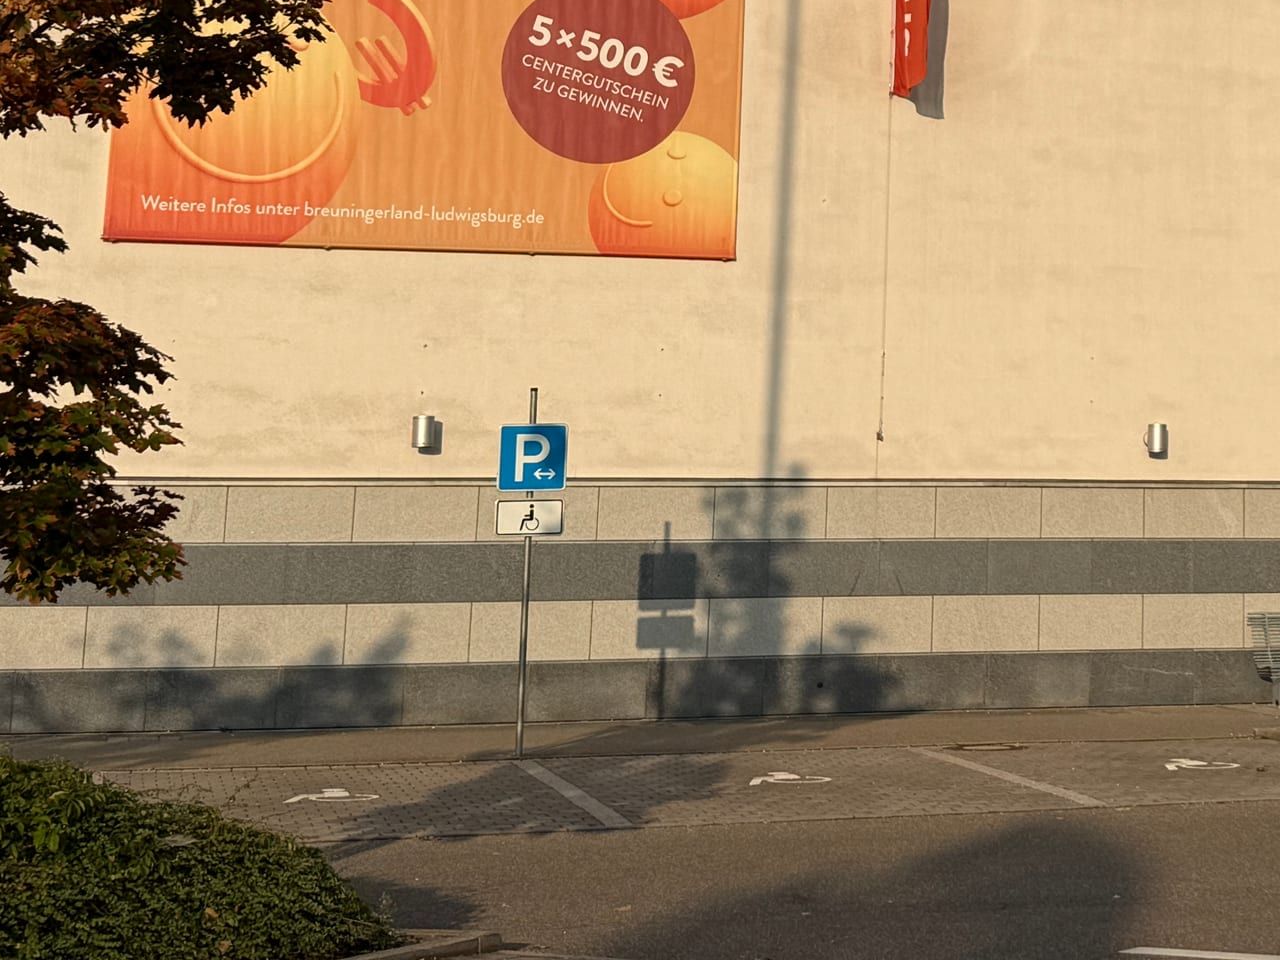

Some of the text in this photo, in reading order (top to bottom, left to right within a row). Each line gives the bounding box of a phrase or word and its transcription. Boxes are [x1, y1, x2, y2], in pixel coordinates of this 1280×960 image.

[522, 54, 669, 110] CENTERGUTSCHEIN
[533, 77, 644, 123] ZU GEWINNEN.
[141, 195, 544, 229] Weitere Infos unter breuningerland-ludwigsburg.de
[514, 434, 550, 482] P
